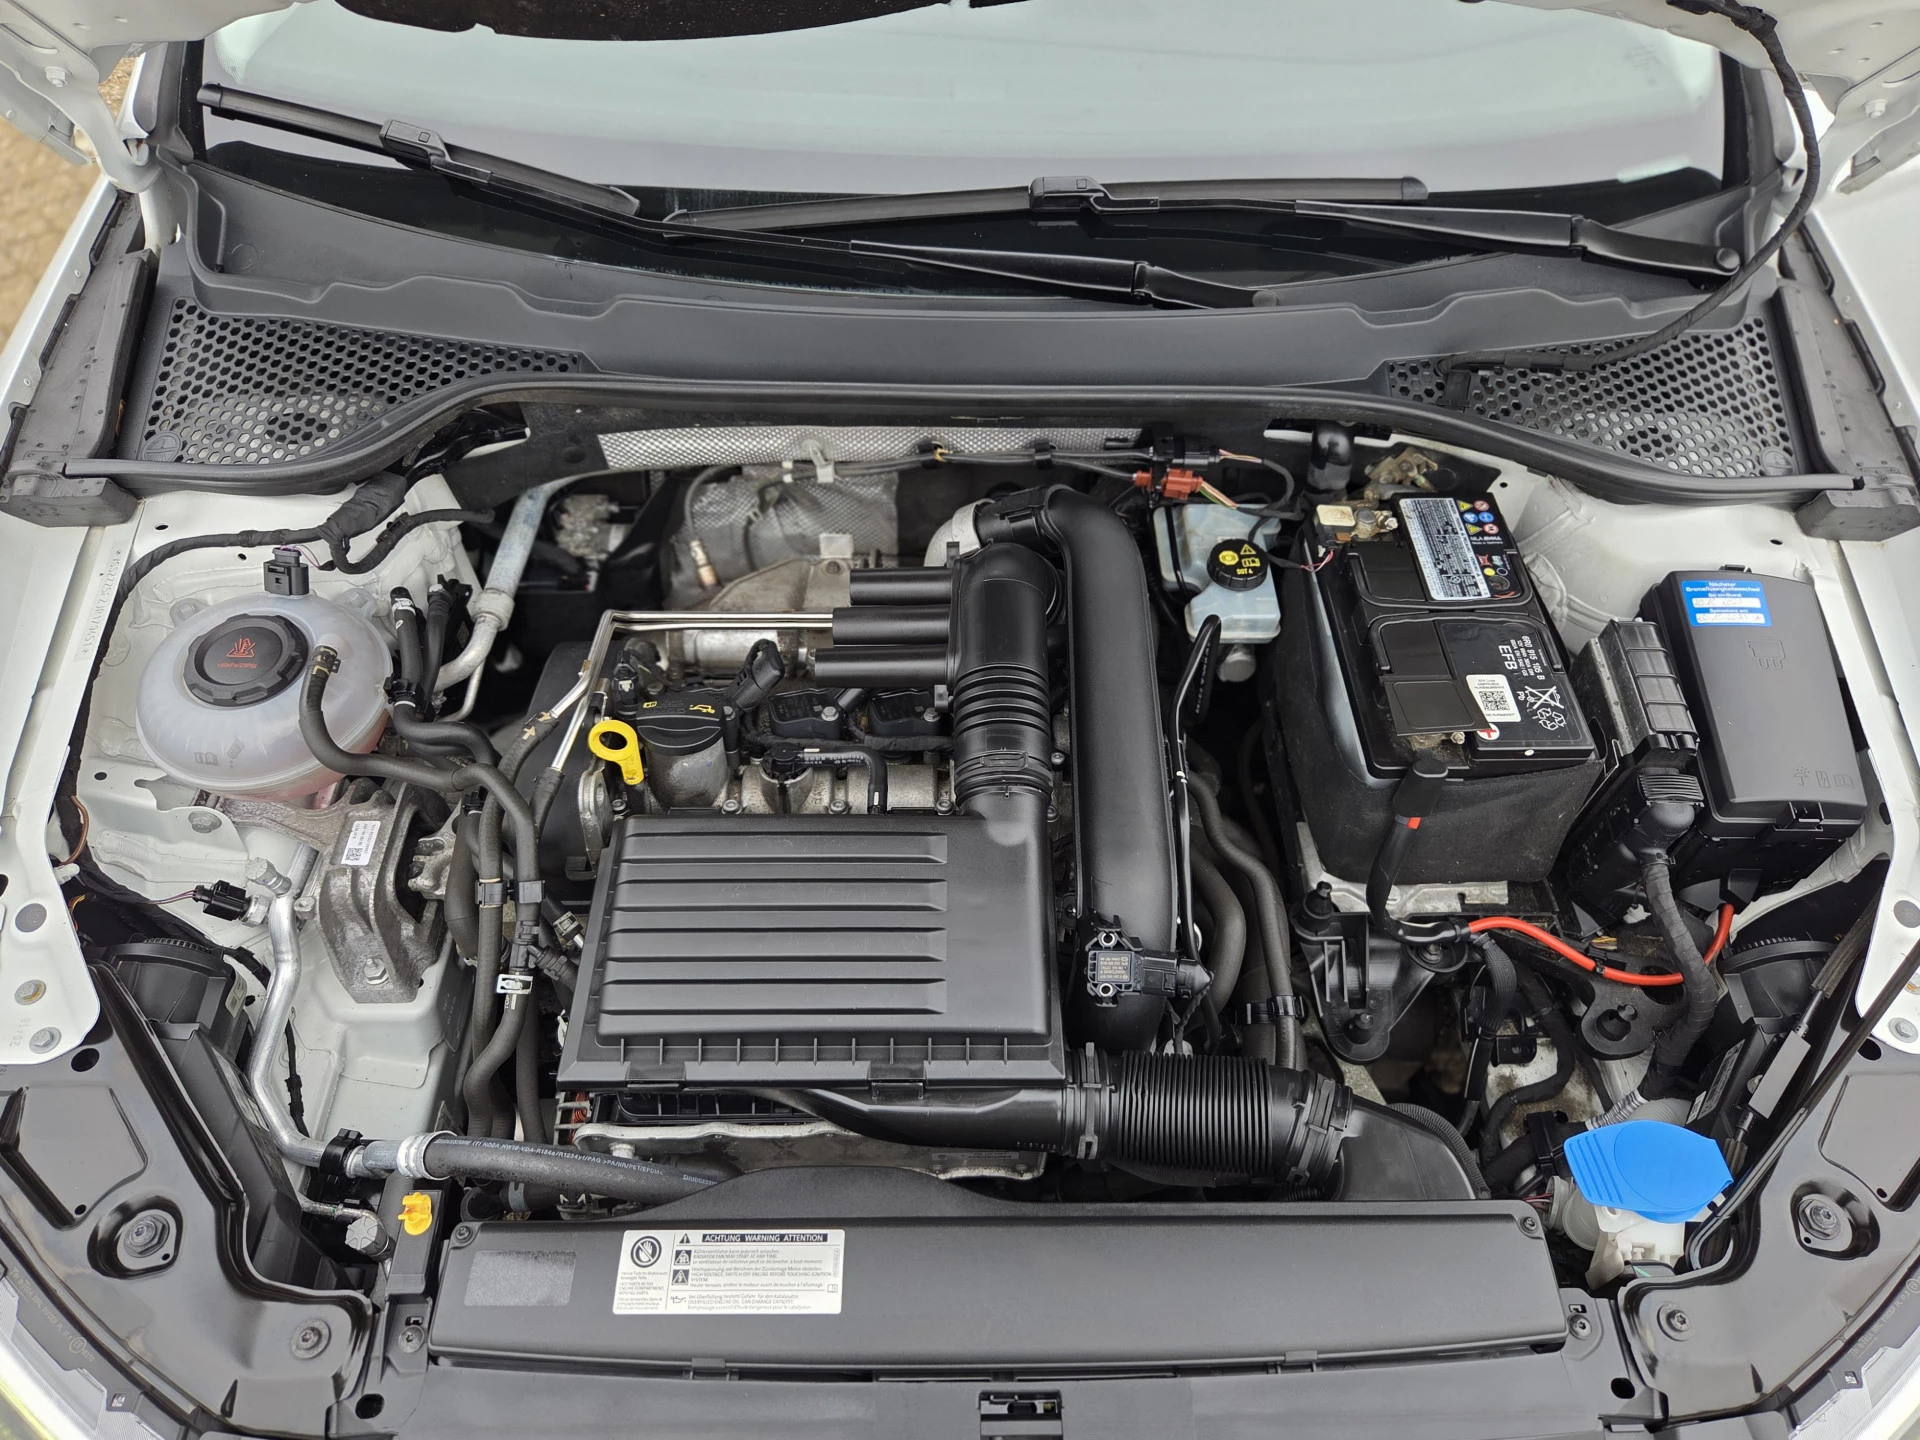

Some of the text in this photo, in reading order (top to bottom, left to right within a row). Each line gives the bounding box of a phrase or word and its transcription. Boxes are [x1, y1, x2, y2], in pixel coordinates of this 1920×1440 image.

[1498, 645, 1518, 670] EFB
[1521, 635, 1533, 648] 6R0
[1527, 649, 1537, 661] 915
[1533, 662, 1543, 674] 105
[1516, 691, 1526, 701] Pb
[705, 1233, 824, 1242] ACHTUNG WARNING ATTENTION
